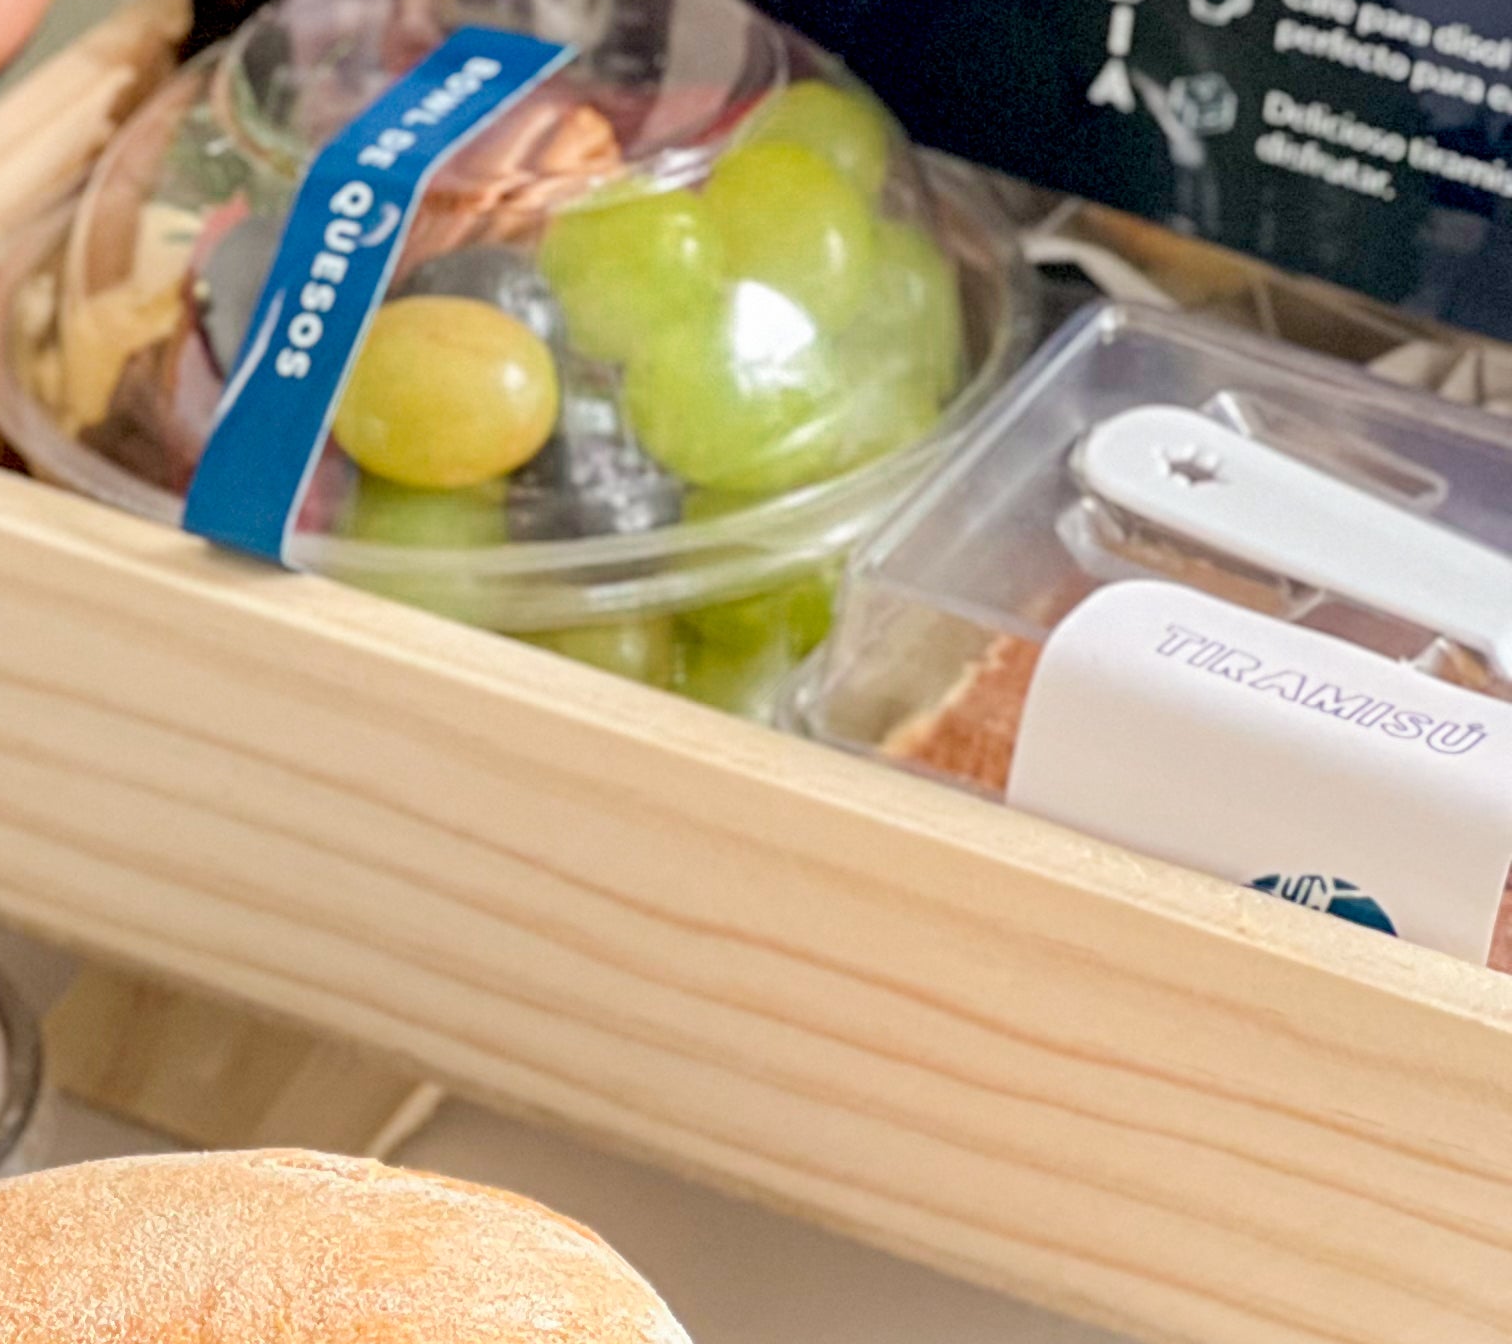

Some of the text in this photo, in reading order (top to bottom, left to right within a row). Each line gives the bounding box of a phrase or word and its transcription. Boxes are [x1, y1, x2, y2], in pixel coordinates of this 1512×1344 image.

[1274, 18, 1412, 82] perfecto
[1409, 60, 1486, 104] para
[1356, 2, 1432, 47] para
[1262, 89, 1407, 163] Delicioso
[1254, 131, 1397, 202] disfrutar.
[274, 55, 503, 379] BOWL DE QUESOS
